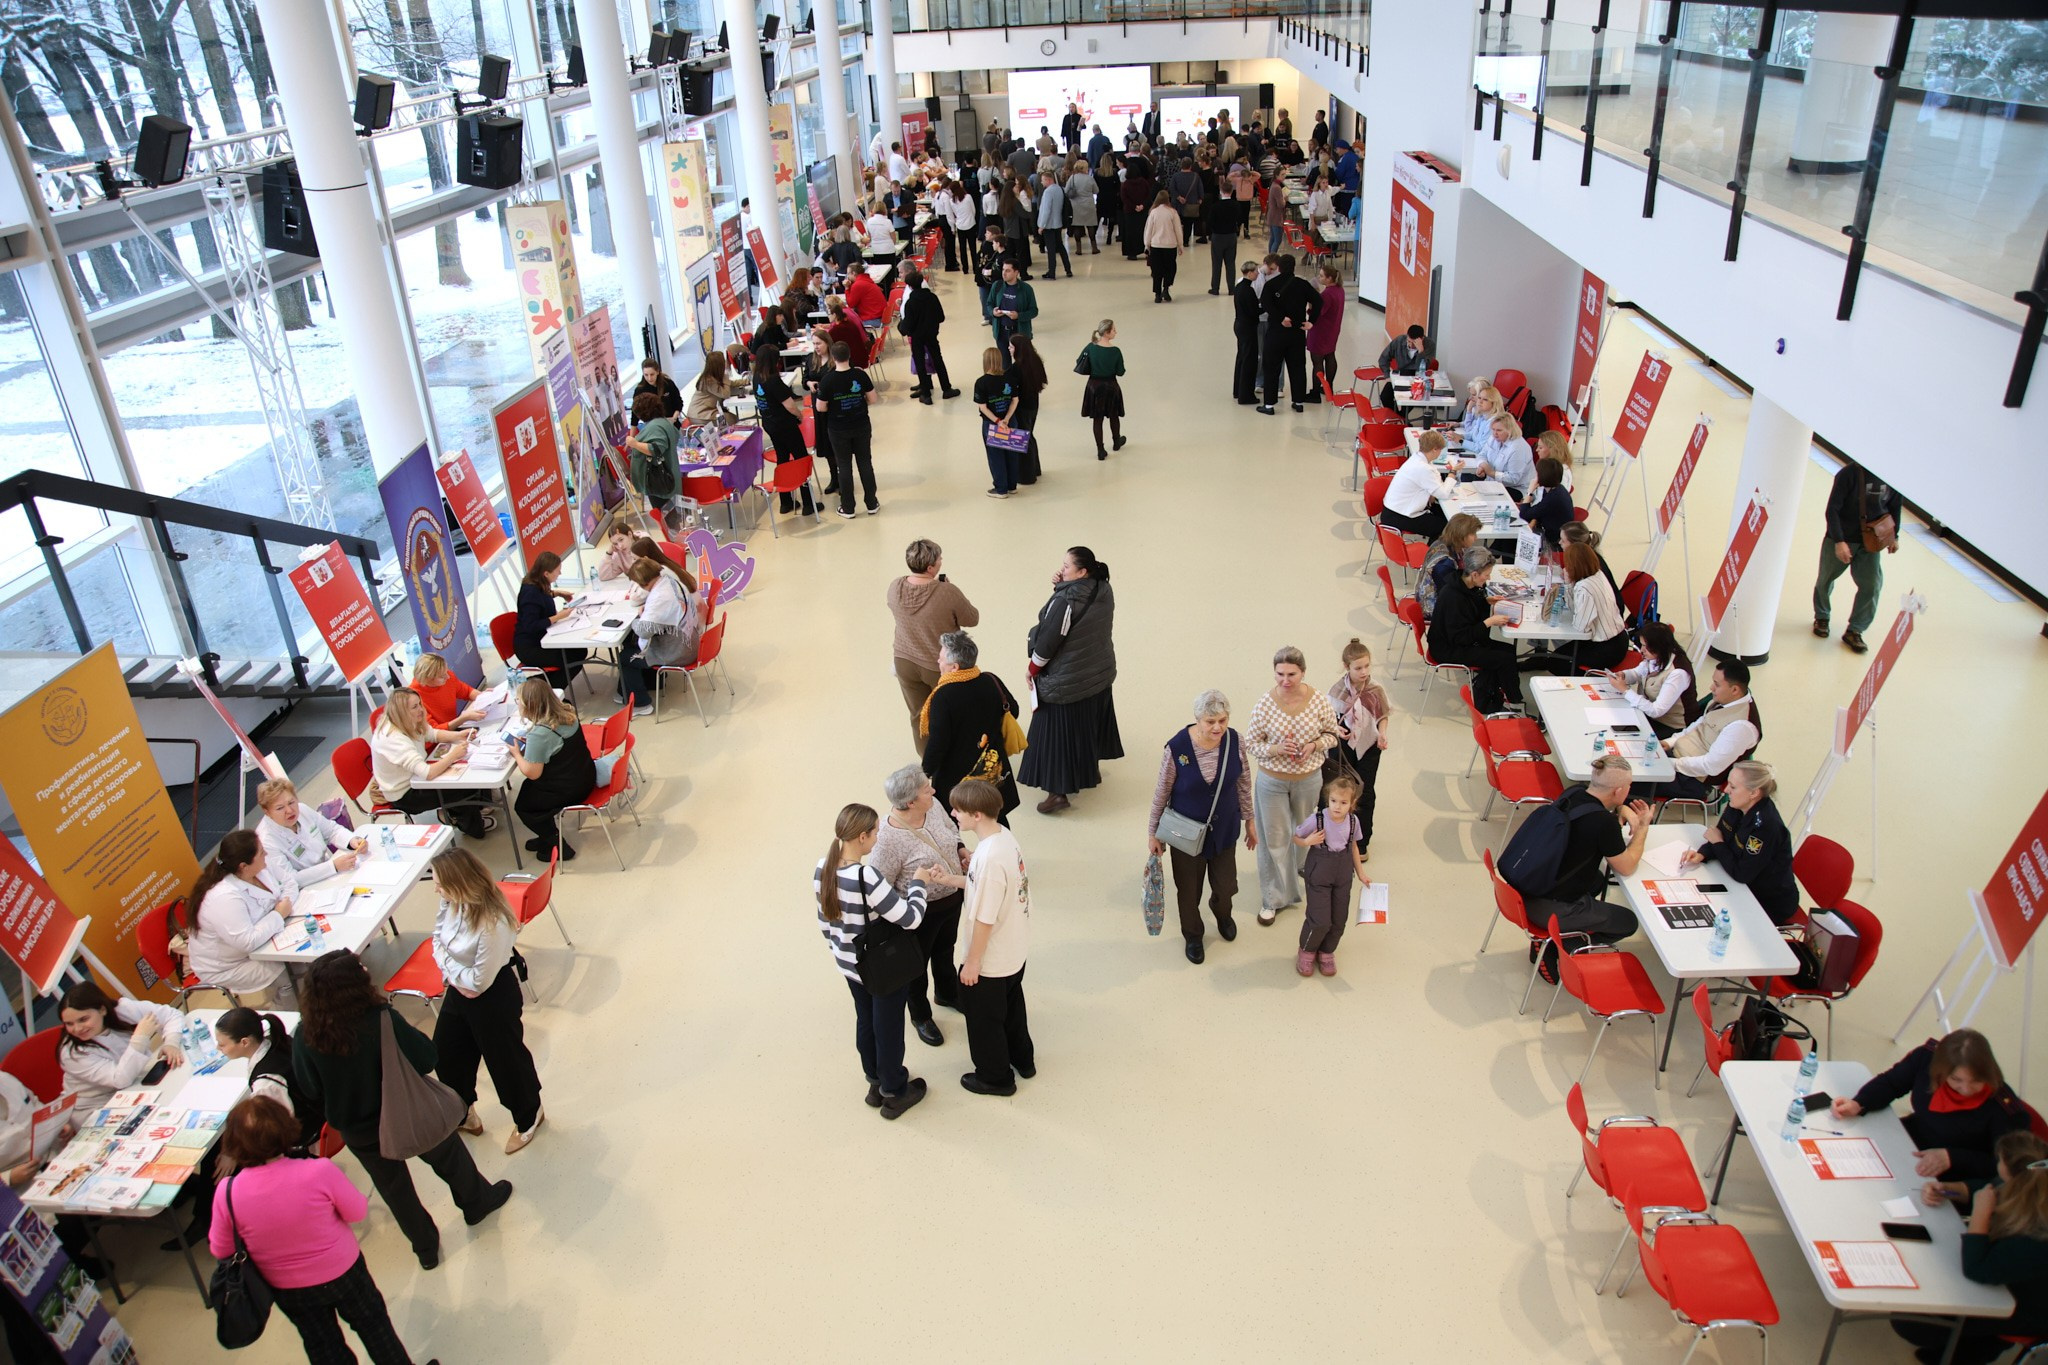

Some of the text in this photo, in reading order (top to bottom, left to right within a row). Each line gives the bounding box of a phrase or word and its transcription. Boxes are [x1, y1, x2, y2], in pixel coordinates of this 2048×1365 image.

[519, 470, 556, 508] ИСПОЛНИТЕЛЬНОЙ
[526, 467, 544, 486] ОРГАНЫ
[522, 496, 563, 537] ПОДВЕДОМСТВЕННЫЕ
[531, 497, 547, 514] ВЛАСТИ
[532, 514, 560, 545] ОРГАНИЗАЦИИ
[329, 600, 359, 628] ДЕПАРТАМЕНТ
[329, 604, 369, 641] ЗДРАВООХРАНЕНИЯ
[336, 615, 373, 650] ГОРОДА МОСКВЫ
[36, 725, 130, 802] Профилактика, лечение
[64, 745, 119, 794] реабилитация
[66, 783, 93, 809] сфере
[92, 757, 127, 788] детского
[55, 760, 141, 834] ментального здоровья
[88, 802, 106, 821] 1895
[107, 787, 125, 806] года
[0, 875, 22, 915] ОРОДСКИЕ
[121, 869, 156, 906] Внимание
[2006, 863, 2033, 921] ПРИСТАВОВ
[2018, 850, 2044, 901] СУДЕБНЫХ
[3, 883, 33, 931] ПОЛИКЛИНИКИ
[120, 892, 147, 923] каждой
[148, 870, 172, 896] детали
[122, 905, 150, 936] истории
[151, 876, 179, 907] ребенка
[18, 916, 30, 934] ГБУЗ
[19, 914, 47, 961] НАРКОЛОГИИ
